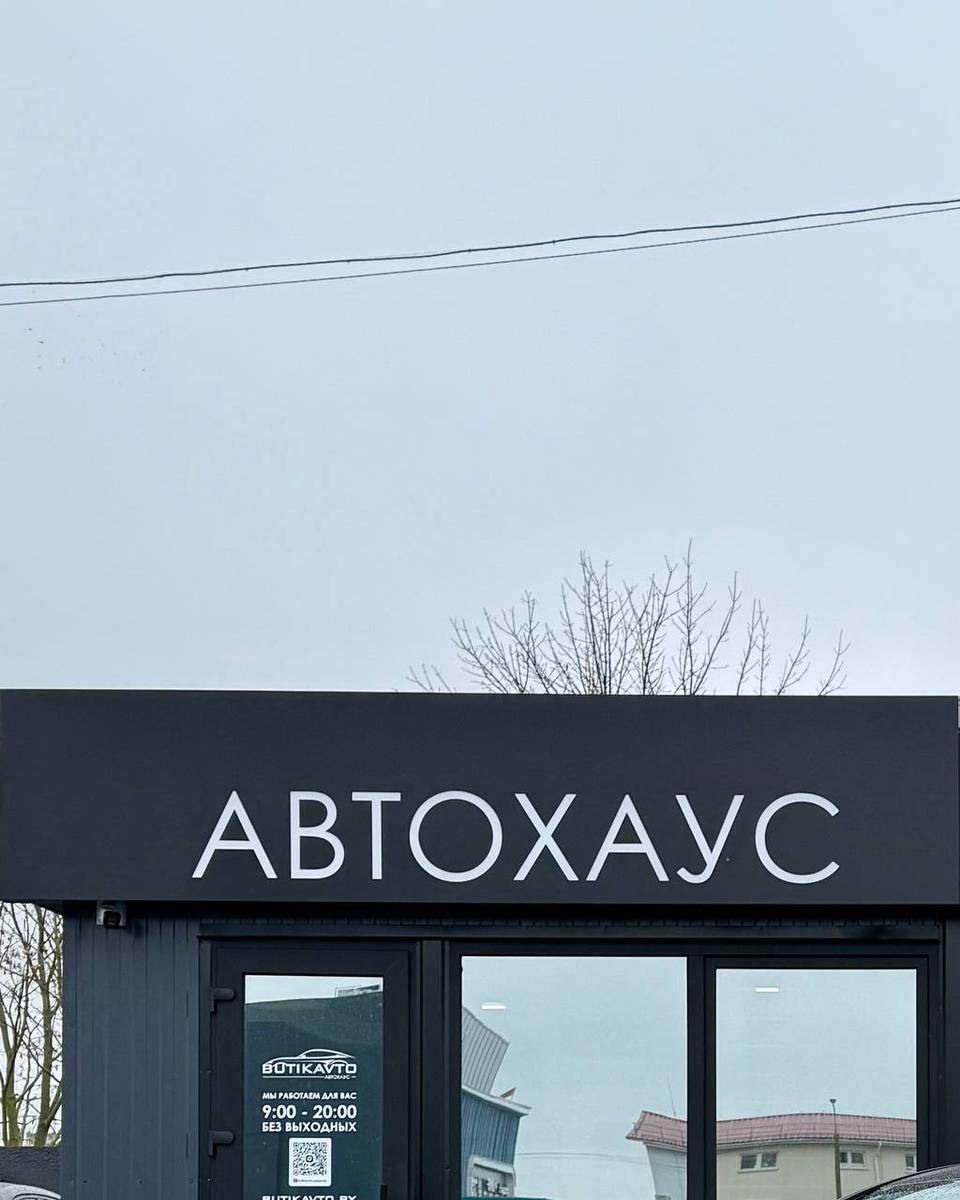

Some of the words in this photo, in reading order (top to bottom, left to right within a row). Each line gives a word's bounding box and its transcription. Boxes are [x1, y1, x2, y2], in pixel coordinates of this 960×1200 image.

[191, 790, 840, 884] АВТОХАУС
[262, 1063, 357, 1074] BUTIKAVTO
[278, 1092, 321, 1100] РАБОТАЕМ
[321, 1092, 339, 1100] ДЛЯ
[340, 1092, 357, 1100] ВАС
[262, 1104, 297, 1119] 9:00
[312, 1104, 358, 1119] 20:00
[262, 1122, 282, 1133] БЕЗ
[285, 1122, 358, 1133] ВЫХОДНЫХ
